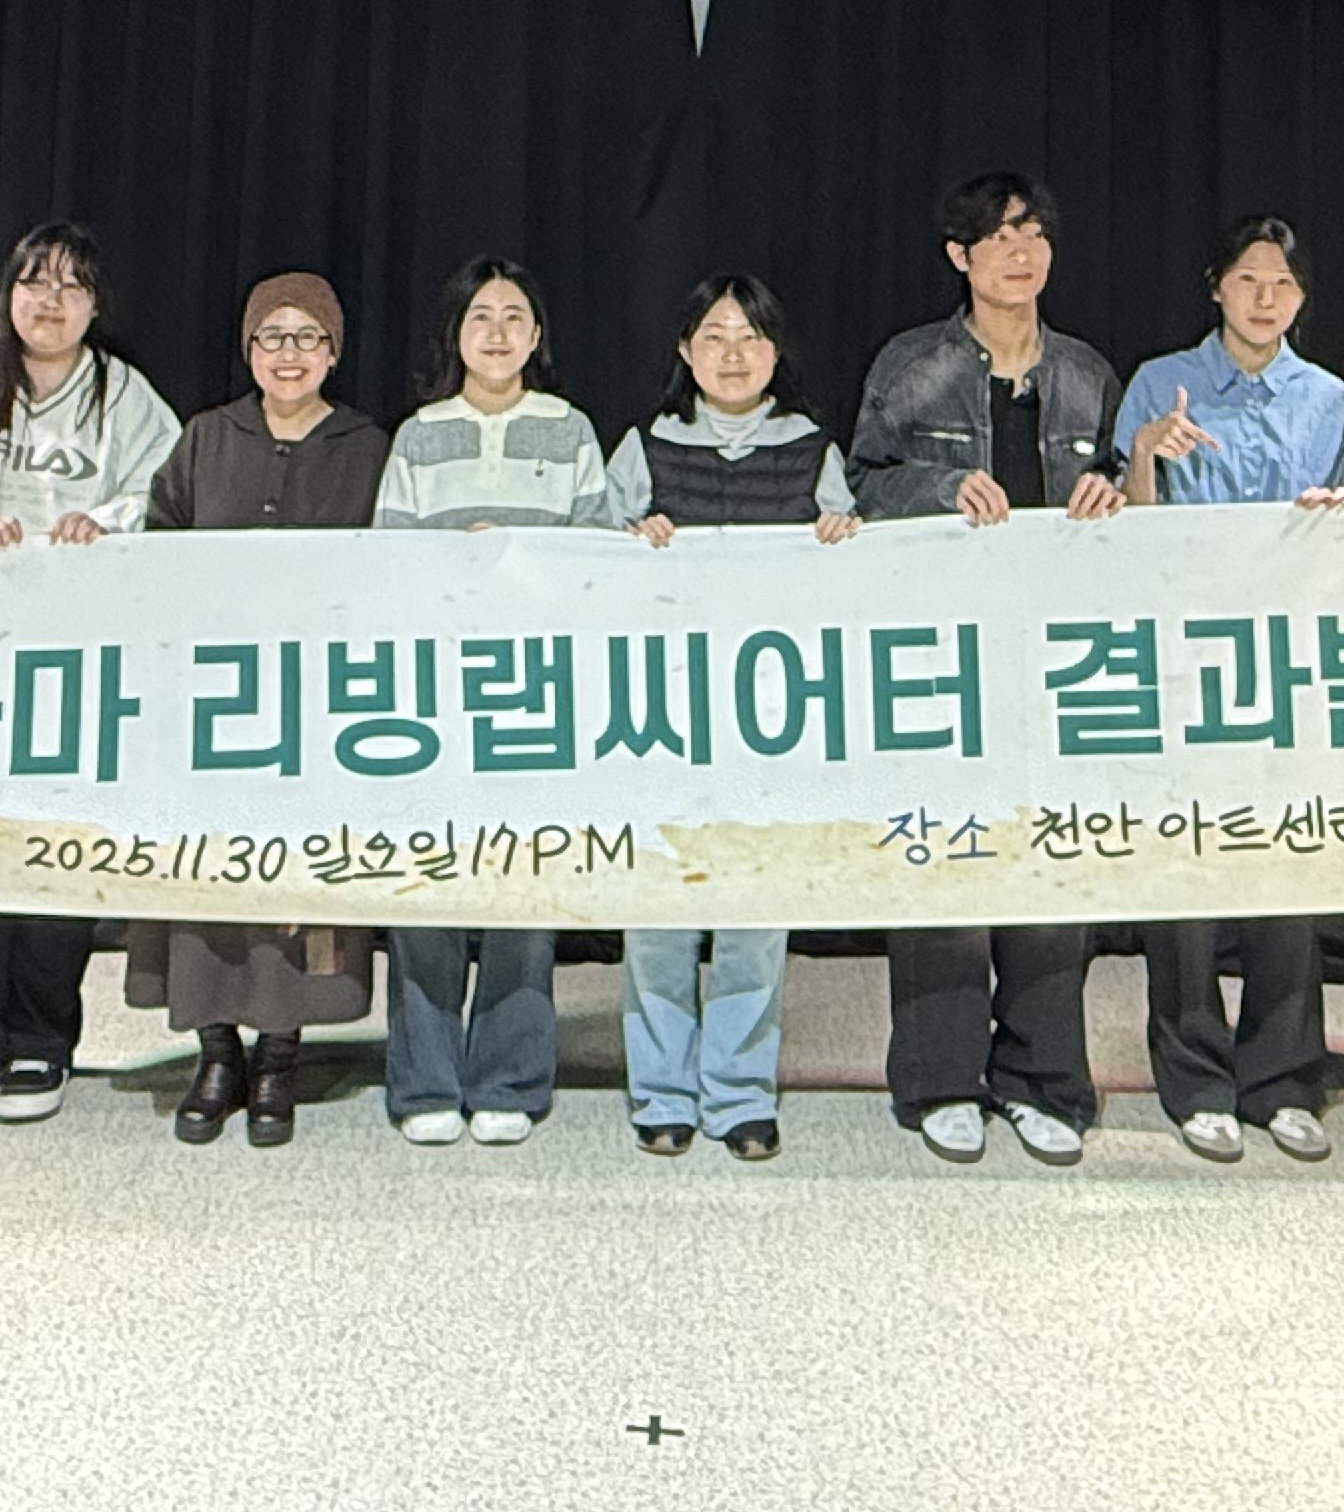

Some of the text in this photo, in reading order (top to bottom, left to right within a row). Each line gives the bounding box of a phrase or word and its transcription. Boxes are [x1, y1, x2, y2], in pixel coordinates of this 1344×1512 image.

[190, 622, 985, 778] 리빙랩씨어터
[24, 833, 288, 884] 2025.11.30
[878, 805, 998, 866] 장소
[1030, 800, 1144, 861] 천안
